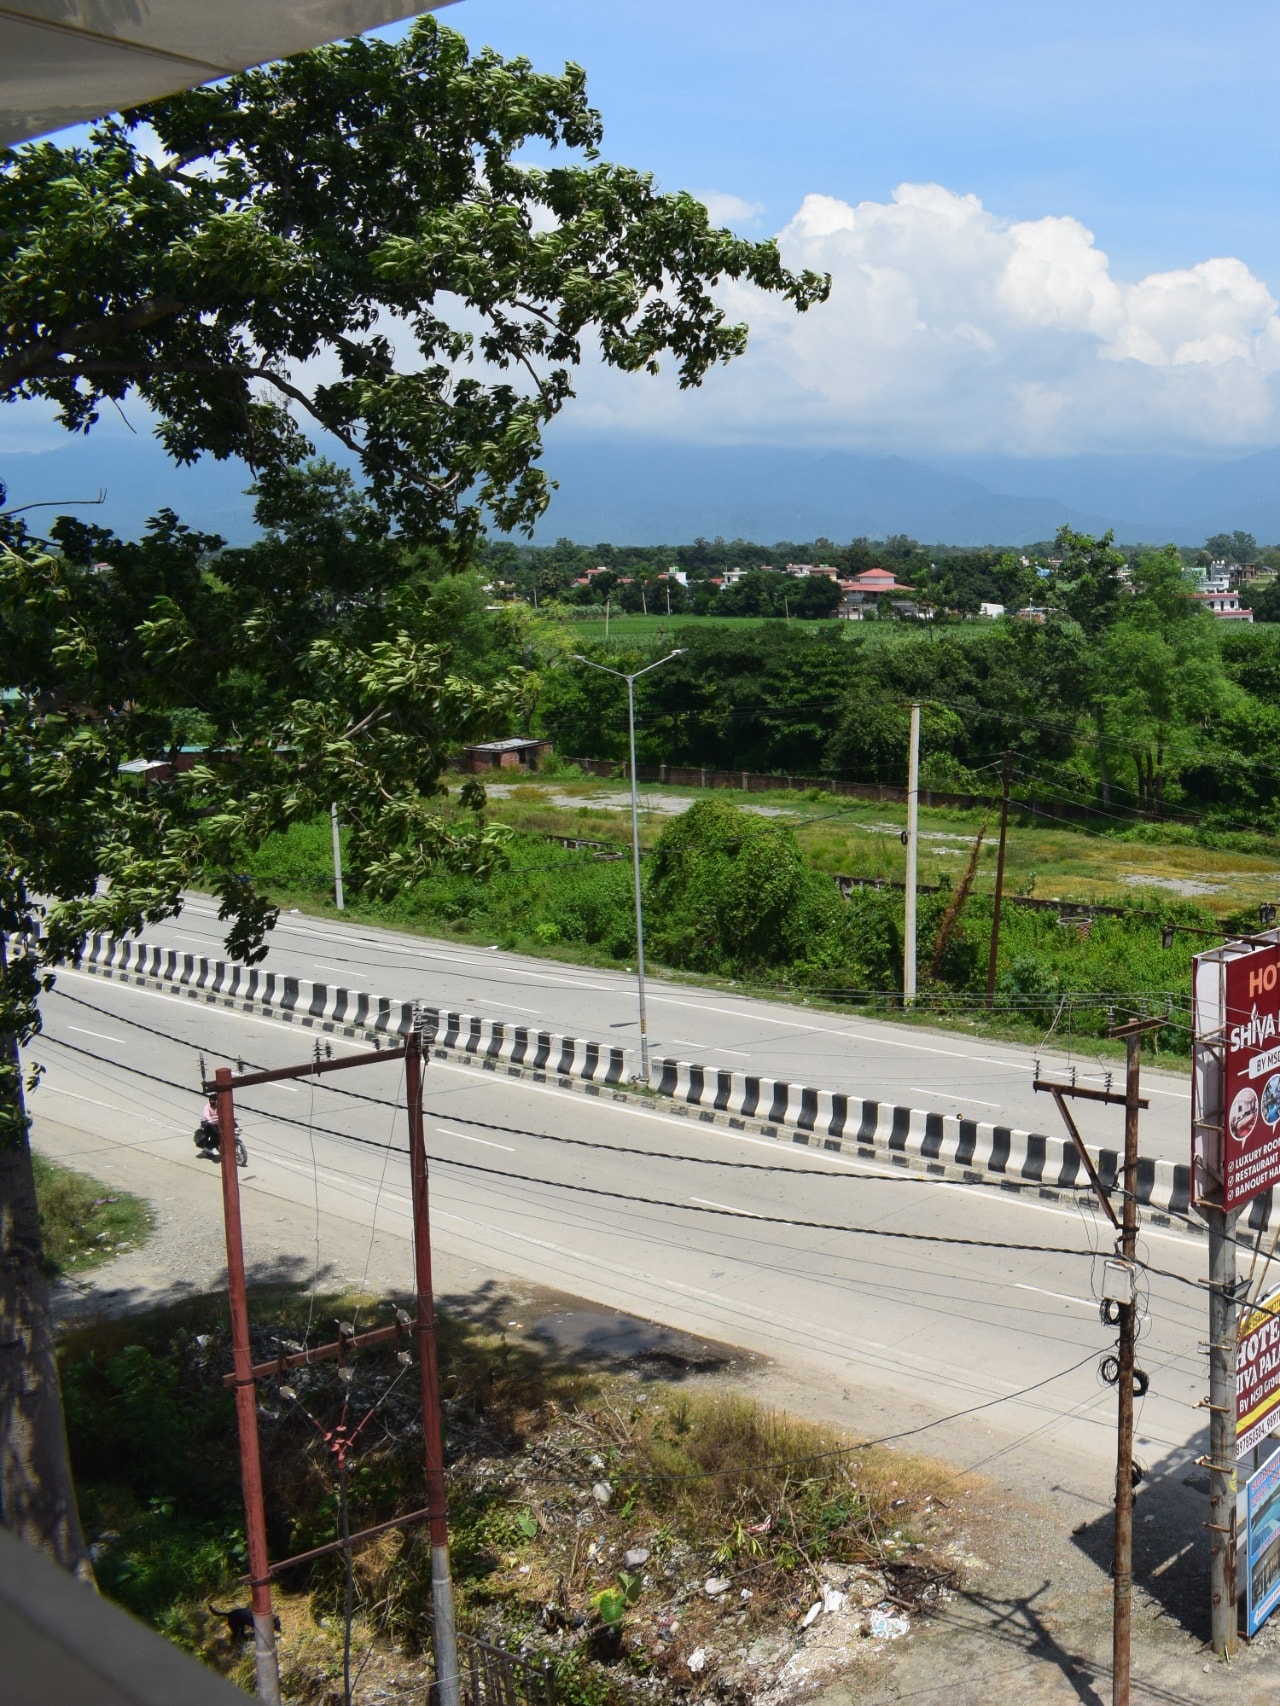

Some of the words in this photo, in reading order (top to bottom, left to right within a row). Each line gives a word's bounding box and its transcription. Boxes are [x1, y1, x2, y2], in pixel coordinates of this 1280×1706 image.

[1230, 1002, 1276, 1052] SHIVA
[1257, 1059, 1265, 1072] BY
[1235, 1146, 1262, 1169] LUXURY
[1235, 1152, 1279, 1182] RESTAURANT
[1235, 1173, 1268, 1197] BANQUET
[1236, 1364, 1257, 1396] IVA
